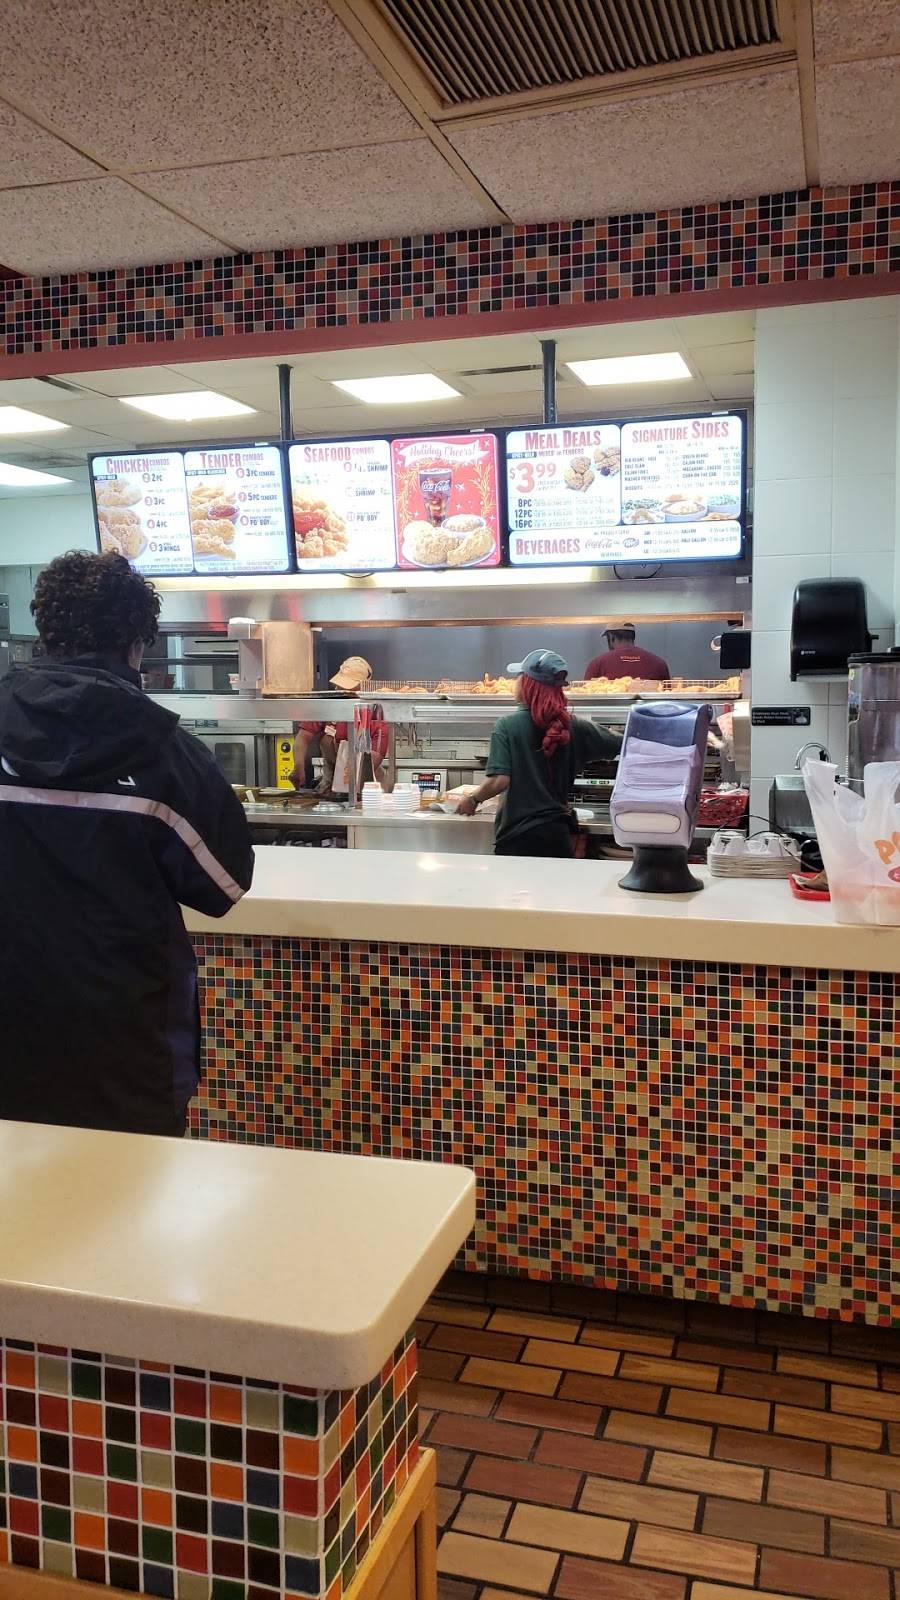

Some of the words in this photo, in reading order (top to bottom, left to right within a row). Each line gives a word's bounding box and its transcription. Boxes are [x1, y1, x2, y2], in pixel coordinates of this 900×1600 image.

[525, 431, 560, 450] MEAL
[563, 430, 601, 449] DEALS
[632, 426, 688, 444] SIGNATURE
[692, 420, 729, 439] SIDES
[304, 446, 351, 463] SEAFOOD
[410, 444, 442, 458] Holiday
[106, 458, 150, 474] CHICKEN
[200, 452, 242, 469] TENDER
[515, 509, 532, 518] 12PC
[515, 519, 532, 528] 16PC
[515, 538, 580, 555] BEVERAGES
